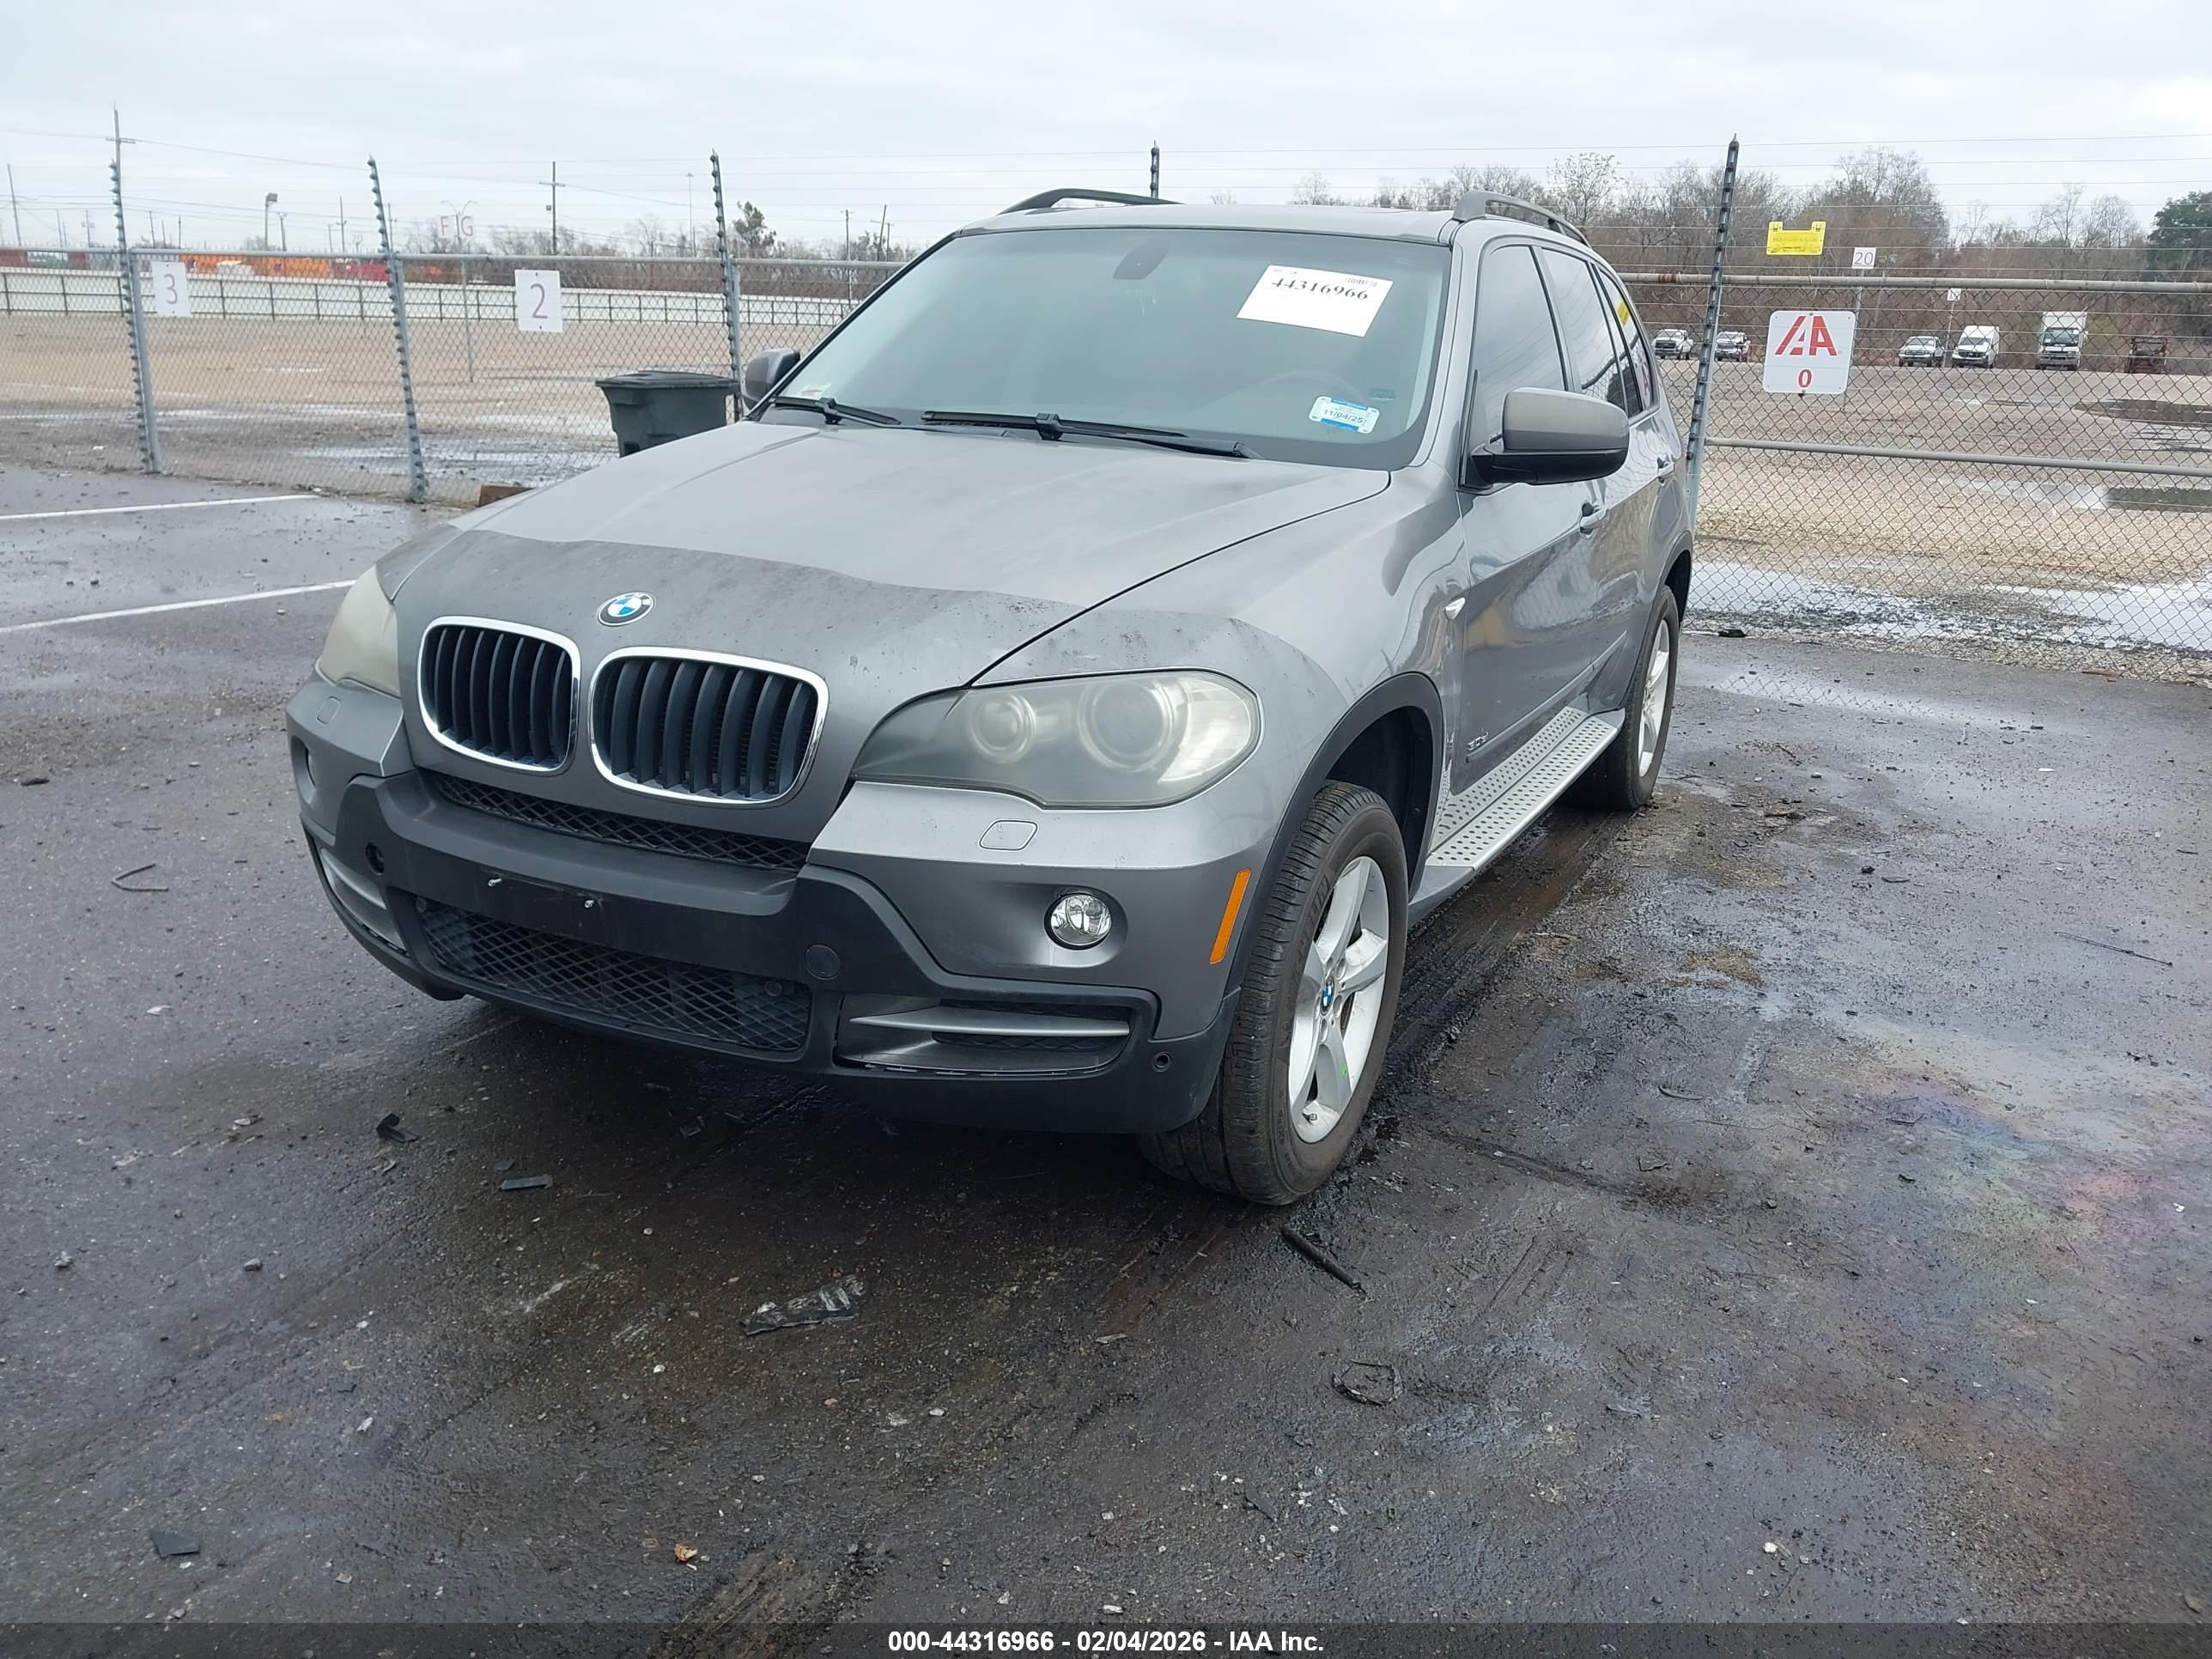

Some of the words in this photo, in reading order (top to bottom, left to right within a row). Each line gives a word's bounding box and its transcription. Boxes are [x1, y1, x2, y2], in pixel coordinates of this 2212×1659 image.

[440, 216, 449, 236] F
[461, 216, 473, 236] G
[1855, 252, 1874, 265] 20
[164, 274, 178, 304] 3
[1271, 277, 1368, 301] 44316966
[531, 283, 548, 319] 2
[1798, 369, 1813, 388] 0
